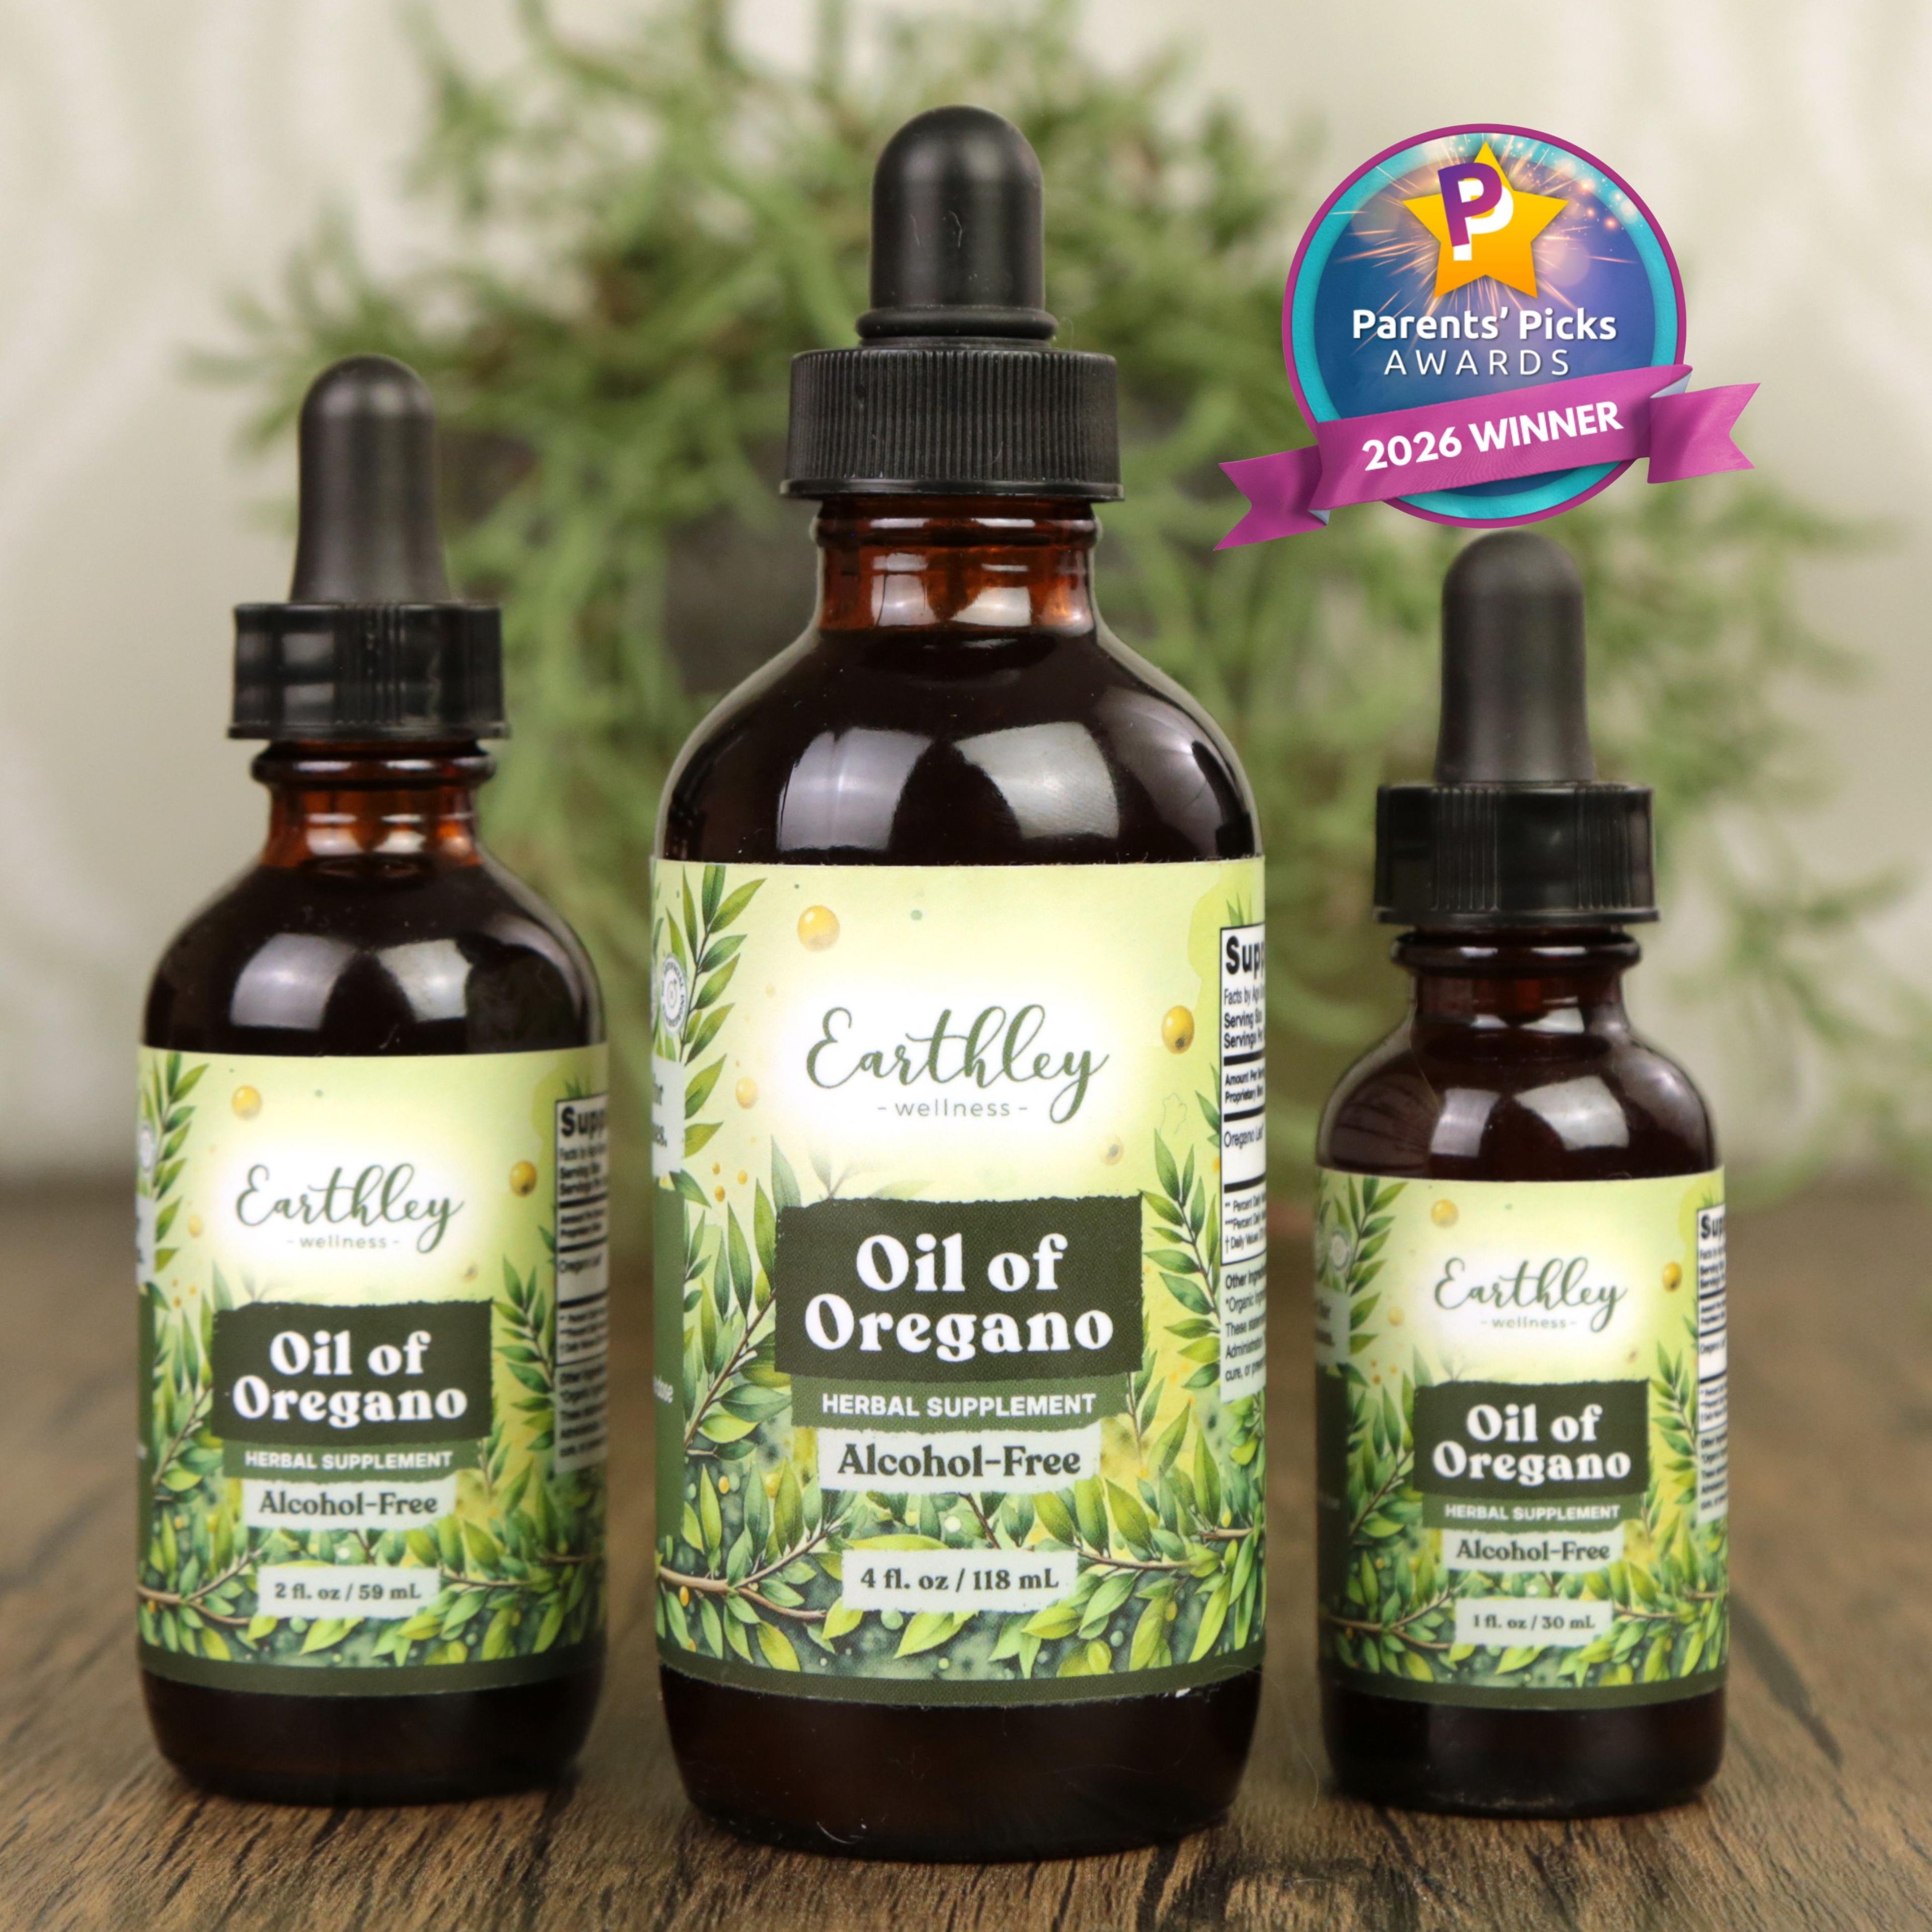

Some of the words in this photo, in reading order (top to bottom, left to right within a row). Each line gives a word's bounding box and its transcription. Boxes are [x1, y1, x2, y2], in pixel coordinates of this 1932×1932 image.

[1224, 1011, 1253, 1029] Serving
[806, 1004, 1110, 1124] Earthley
[895, 1099, 1010, 1116] wellness
[1224, 1131, 1254, 1149] Oregano
[236, 1163, 464, 1254] Earthley
[299, 1235, 387, 1249] wellness
[856, 1233, 965, 1292] Oil
[987, 1233, 1069, 1292] of
[1226, 1273, 1246, 1289] Other
[1434, 1257, 1628, 1333] Earthley
[805, 1293, 1113, 1362] Oregano
[270, 1330, 352, 1376] Oil
[368, 1330, 432, 1376] of
[232, 1375, 467, 1428] Oregano
[822, 1393, 921, 1416] HERBAL
[927, 1393, 1097, 1417] SUPPLEMENT
[1467, 1403, 1539, 1441] Oil
[1551, 1403, 1603, 1442] of
[245, 1450, 317, 1469] HERBAL
[322, 1451, 453, 1470] SUPPLEMENT
[838, 1443, 1081, 1477] Alcohol-Free
[1433, 1440, 1632, 1487] Oregano
[259, 1490, 439, 1516] Alcohol-Free
[1444, 1503, 1509, 1520] HERBAL
[1513, 1504, 1621, 1521] SUPPLEMENT
[1457, 1539, 1610, 1560] Alcohol-Free
[275, 1583, 286, 1599] 2
[292, 1583, 311, 1599] fl.
[317, 1587, 341, 1599] oz
[346, 1583, 353, 1601] /
[358, 1584, 383, 1599] 59
[389, 1583, 422, 1599] mL
[860, 1568, 875, 1589] 4
[884, 1568, 911, 1590] fl.
[918, 1574, 949, 1590] oz
[956, 1568, 965, 1592] /
[973, 1569, 1011, 1590] 118
[1018, 1568, 1059, 1589] mL
[1473, 1615, 1480, 1628] 1
[1485, 1614, 1501, 1628] fl.
[1507, 1618, 1527, 1629] oz
[1530, 1615, 1537, 1631] /
[1542, 1616, 1565, 1629] 30
[1570, 1615, 1595, 1630] mL
